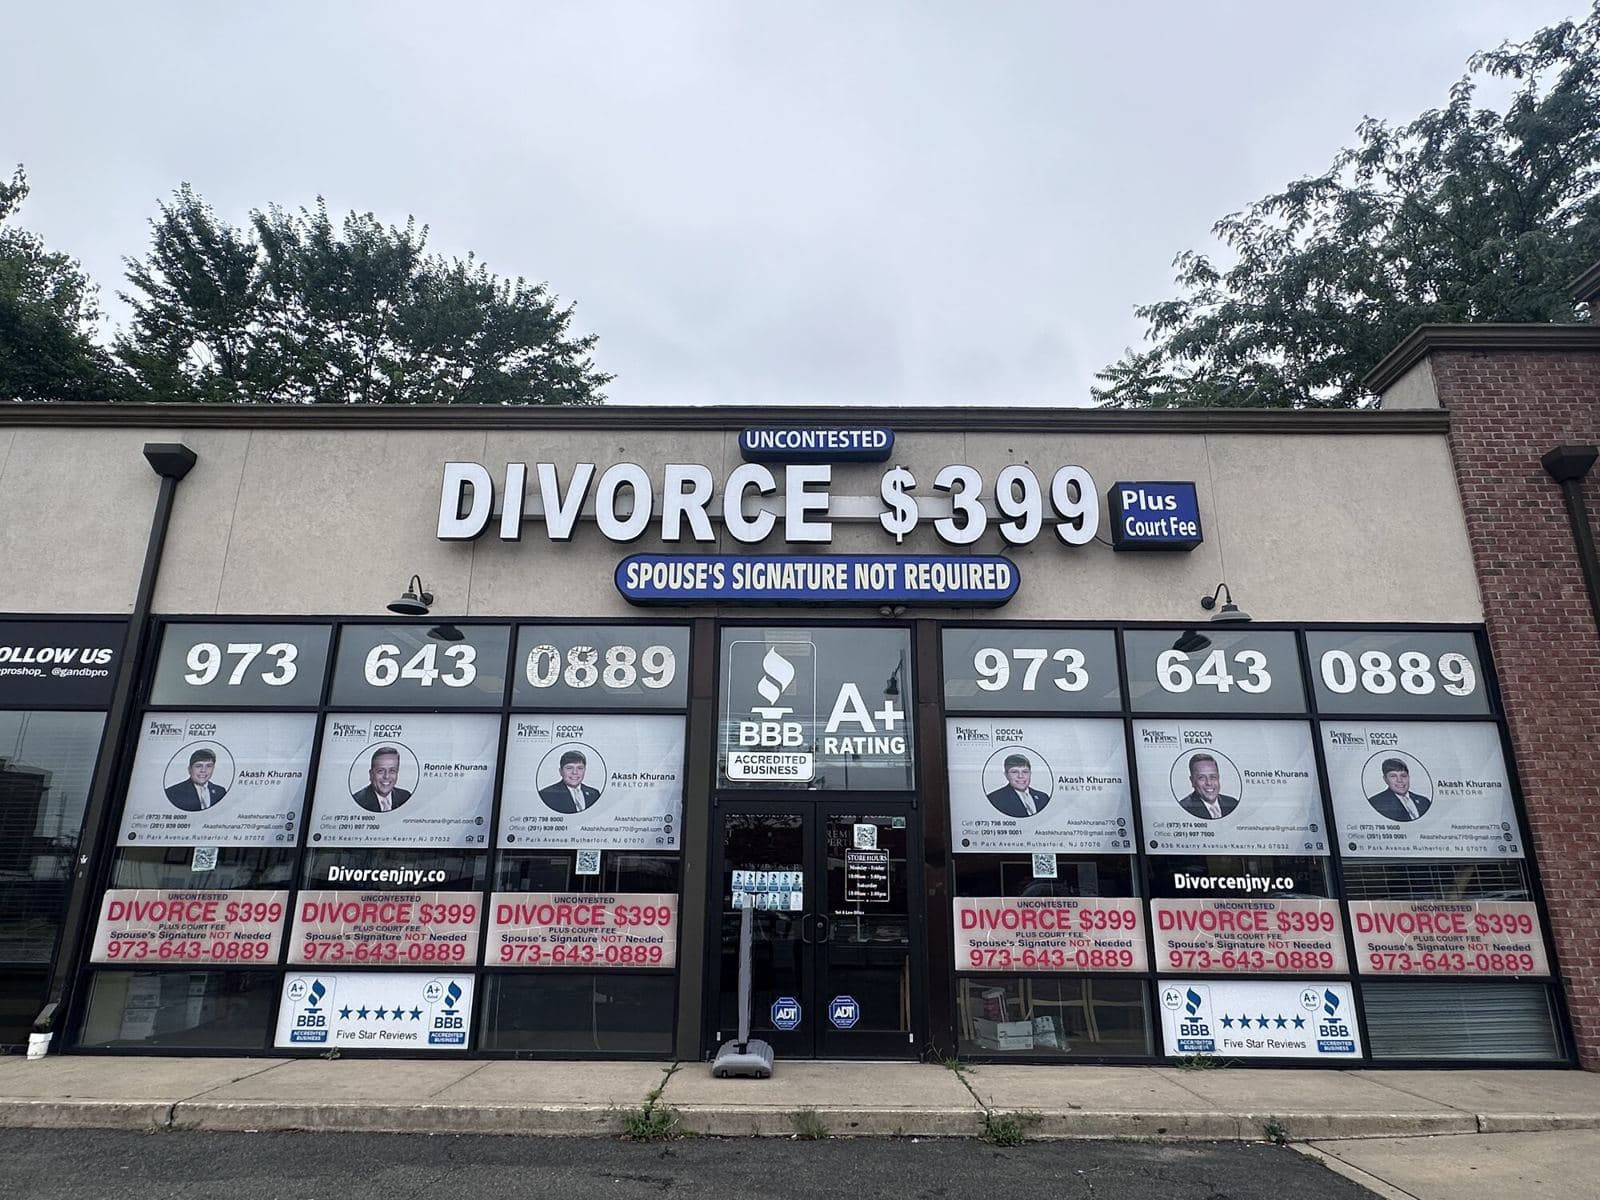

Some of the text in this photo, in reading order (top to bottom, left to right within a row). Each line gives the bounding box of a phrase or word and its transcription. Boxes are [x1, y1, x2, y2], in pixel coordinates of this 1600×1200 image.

[745, 430, 888, 450] UNCONTESTED
[436, 462, 1100, 546] DIVORCE $399
[1121, 490, 1178, 511] Plus
[1125, 516, 1197, 538] Court Fee
[626, 562, 1011, 593] SPOUSE'S SIGNATURE NOT REQUIRED
[80, 648, 113, 664] US
[51, 668, 108, 677] @gandbpro
[184, 643, 299, 687] 973
[363, 643, 478, 688] 643
[525, 644, 676, 690] 0889
[974, 648, 1089, 692] 973
[1156, 650, 1272, 694] 643
[1320, 650, 1477, 696] 0889
[825, 683, 904, 733] A+
[739, 721, 804, 747] BBB
[825, 737, 906, 754] RATING
[424, 763, 488, 771] Ronnie Khurana
[735, 755, 807, 765] ACCREDITED
[743, 765, 798, 775] BUSINESS
[1275, 770, 1309, 778] Khurana
[1058, 776, 1122, 784] Akash Khurana
[328, 866, 446, 885] Divorcenjny.co
[1174, 873, 1294, 892] Divorcenjny.co
[107, 901, 282, 924] DIVORCE $399
[302, 903, 476, 925] DIVORCE $399
[497, 905, 671, 928] DIVORCE $399
[961, 909, 1136, 931] DIVORCE $399
[1158, 910, 1334, 933] DIVORCE $399
[1356, 913, 1533, 935] DIVORCE $399
[110, 931, 156, 940] Spouse's
[159, 932, 207, 940] Signature
[234, 932, 271, 940] Needed
[305, 933, 351, 941] Spouse's
[354, 933, 402, 941] Signature
[501, 935, 547, 943] Spouse's
[550, 935, 597, 943] Signature
[970, 940, 1015, 948] Spouse's
[1018, 940, 1066, 948] Signature
[107, 941, 269, 960] 973-643-0889
[303, 943, 465, 961] 973-643-0889
[500, 945, 662, 963] 973-643-0889
[1168, 941, 1214, 949] Spouse's
[1217, 941, 1265, 950] Signature
[1368, 943, 1414, 951] Spouse's
[1417, 943, 1465, 951] Signature
[970, 950, 1133, 967] 973-643-0889
[1169, 951, 1333, 969] 973-643-0889
[1370, 953, 1534, 971] 973-643-0889
[290, 983, 304, 992] A+
[427, 985, 440, 994] A+
[1166, 992, 1178, 1001] A+
[1304, 993, 1317, 1002] A+
[776, 1008, 797, 1019] ADT
[834, 1006, 854, 1018] ADT
[297, 1015, 325, 1027] BBB
[434, 1017, 462, 1028] BBB
[336, 1030, 417, 1040] Five Star Reviews
[1180, 1024, 1209, 1036] BBB
[1320, 1025, 1348, 1036] BBB
[1224, 1039, 1306, 1049] Five Star Reviews
